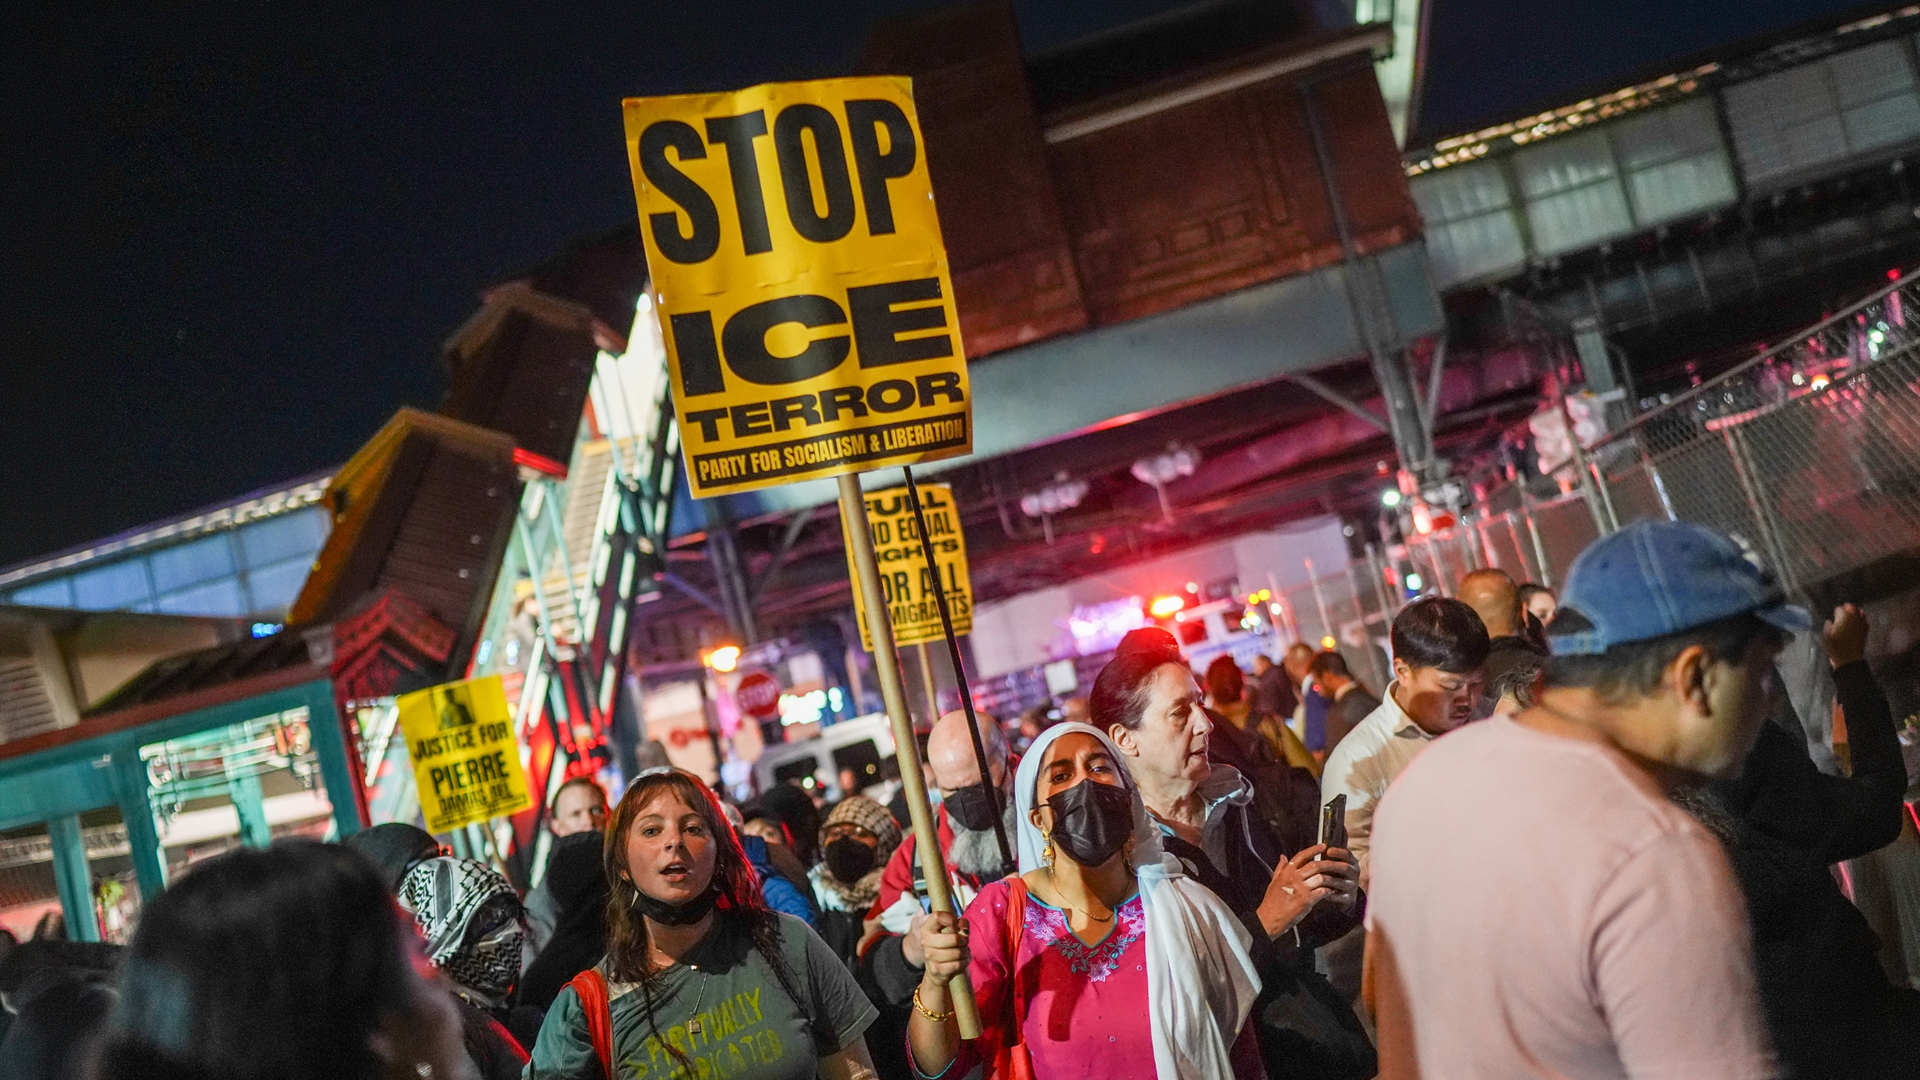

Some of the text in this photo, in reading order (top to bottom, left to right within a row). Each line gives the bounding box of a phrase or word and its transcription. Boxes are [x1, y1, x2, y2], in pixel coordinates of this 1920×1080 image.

[638, 99, 917, 264] STOP
[670, 277, 954, 398] ICE
[686, 371, 965, 443] TERROR
[698, 418, 964, 481] PARTY FOR SOCIALISM & LIBERATION
[414, 722, 509, 763] JUSTICE FOR
[430, 751, 509, 795] PIERRE
